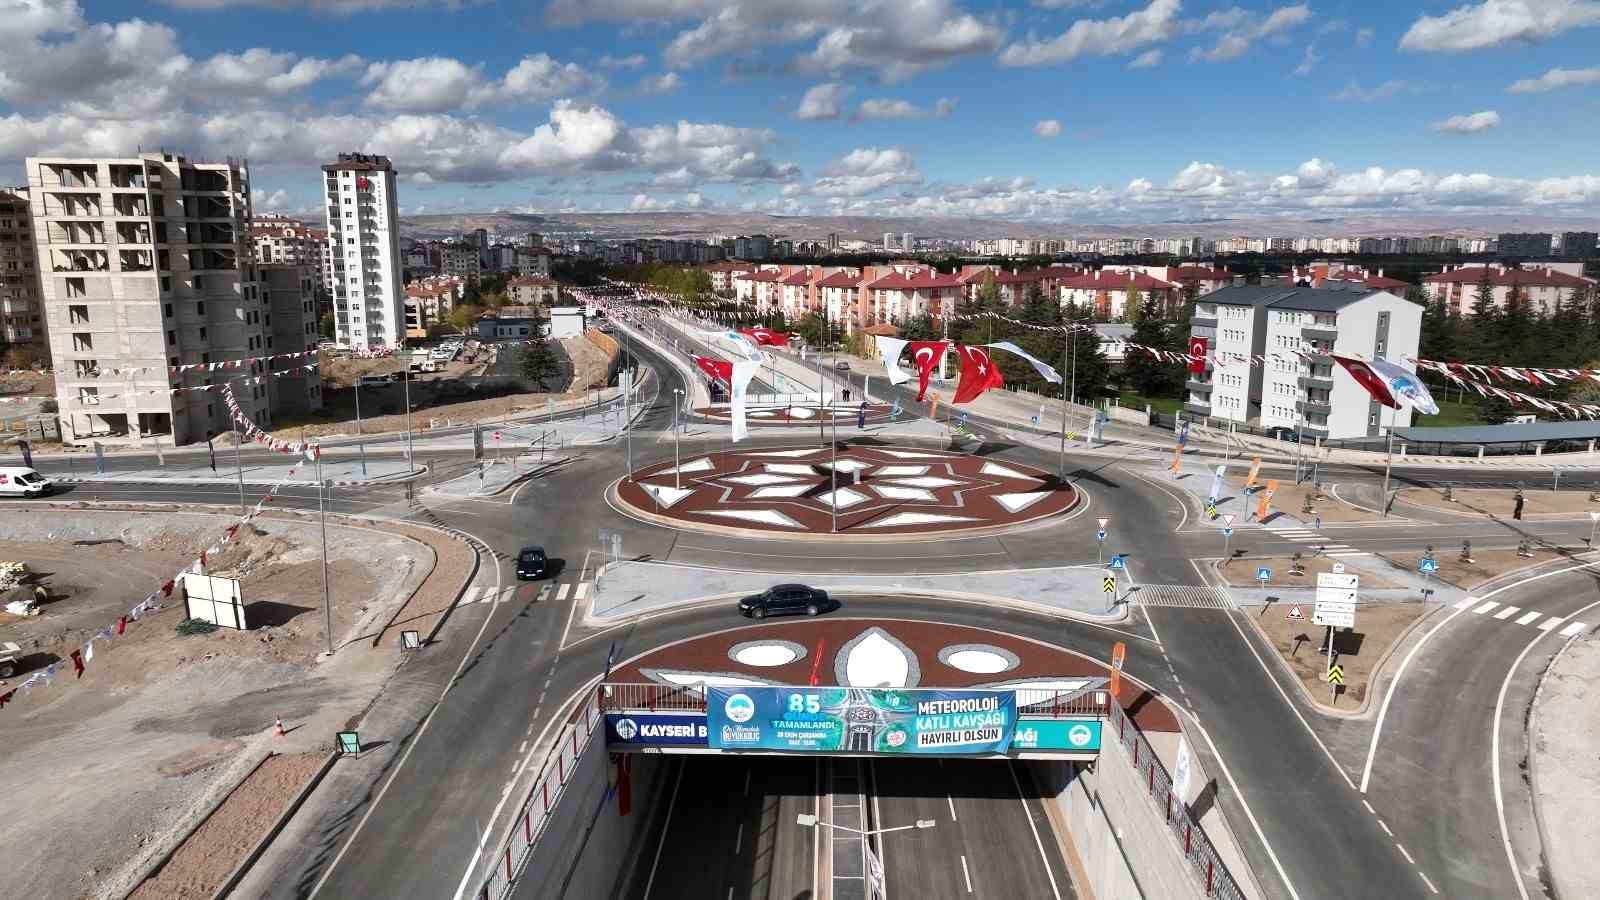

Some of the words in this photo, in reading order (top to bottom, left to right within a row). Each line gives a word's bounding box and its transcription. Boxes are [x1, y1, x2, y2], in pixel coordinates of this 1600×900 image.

[789, 694, 820, 713] 85
[640, 723, 695, 737] KAYSERİ
[774, 720, 835, 729] TAMAMLANDI
[916, 716, 949, 730] KATLI
[921, 732, 960, 744] HAYIRLI
[964, 729, 998, 741] OLSUN
